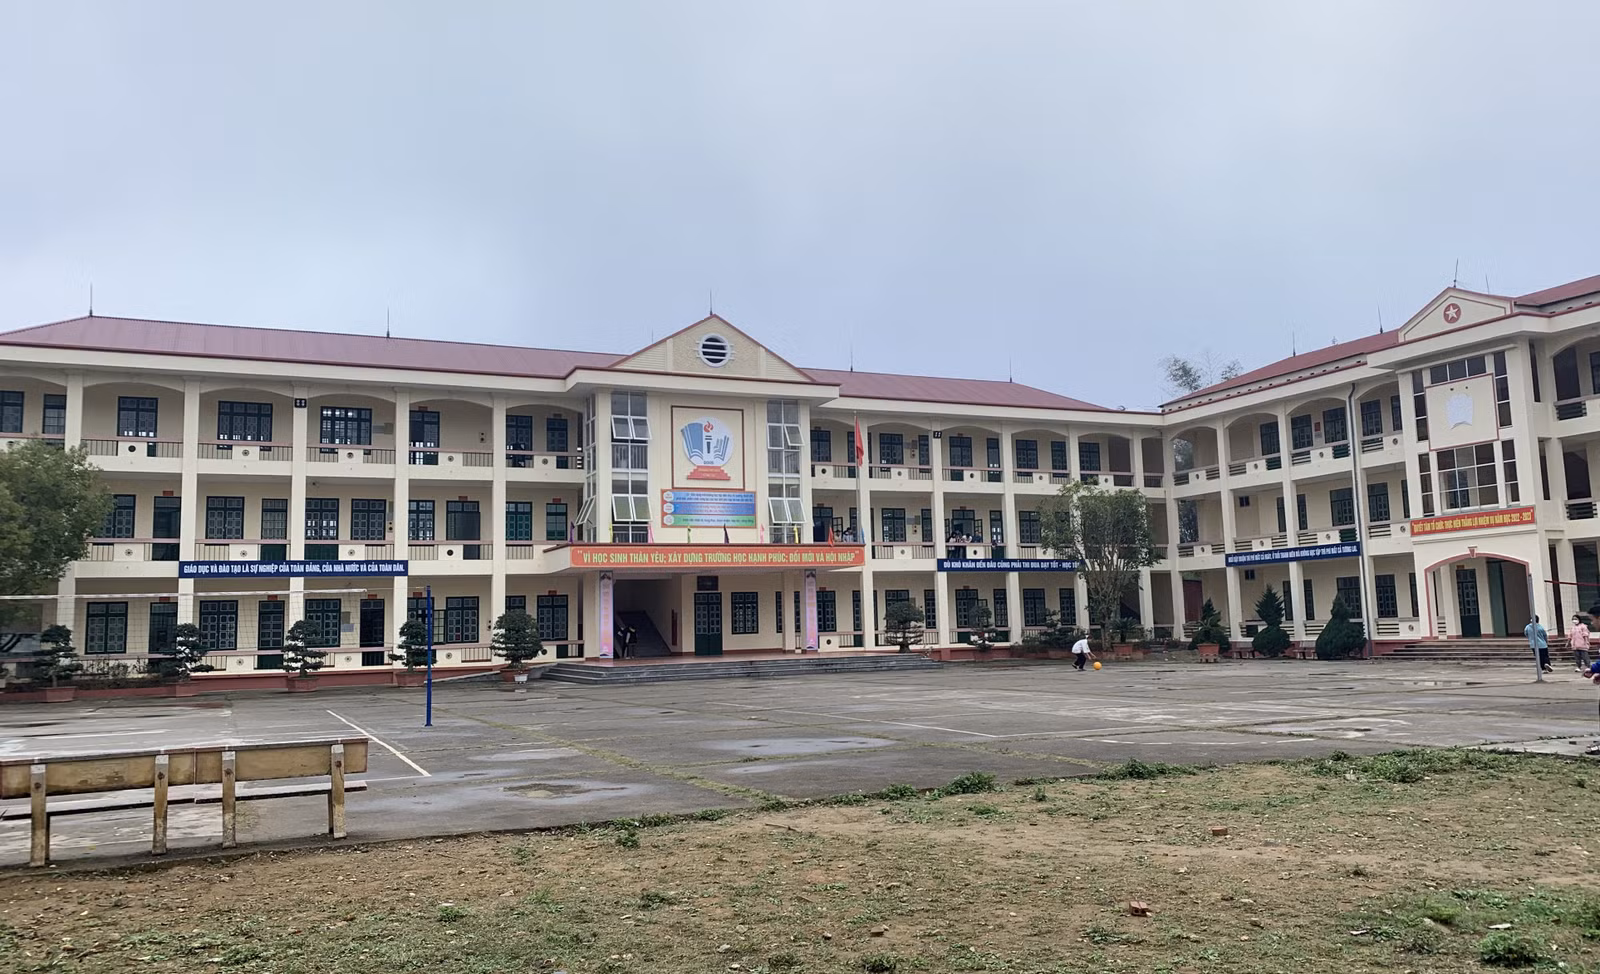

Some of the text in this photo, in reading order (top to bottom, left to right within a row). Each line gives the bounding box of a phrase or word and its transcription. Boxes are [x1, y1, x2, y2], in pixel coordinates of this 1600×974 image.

[592, 553, 608, 565] HỌC
[610, 553, 628, 563] SINH
[630, 551, 649, 563] THÂN
[668, 551, 682, 563] XÂY
[684, 552, 702, 565] DỰNG
[704, 550, 732, 563] TRƯỜNG
[733, 553, 747, 565] HỌC
[748, 553, 767, 564] HẠNH
[789, 550, 800, 562] ĐỔI
[802, 550, 814, 562] MỚI
[816, 551, 824, 562] VÀ
[825, 551, 837, 564] HỘI
[184, 564, 197, 573] GIÁO
[198, 565, 210, 574] DỤC
[210, 564, 218, 573] VÀ
[218, 564, 230, 573] ĐÀO
[231, 565, 241, 574] TẠO
[242, 563, 250, 573] LÀ
[250, 564, 258, 574] SỰ
[258, 563, 278, 574] NGHIỆP
[279, 562, 290, 572] CỦA
[290, 562, 304, 572] TOÀN
[305, 562, 322, 573] ĐẢNG,
[322, 562, 332, 572] CỦA
[333, 563, 344, 572] NHÀ
[345, 562, 359, 572] NƯỚC
[360, 563, 367, 572] VÀ
[368, 562, 378, 572] CỦA
[379, 563, 392, 572] TOÀN
[1011, 560, 1022, 568] PHẢI
